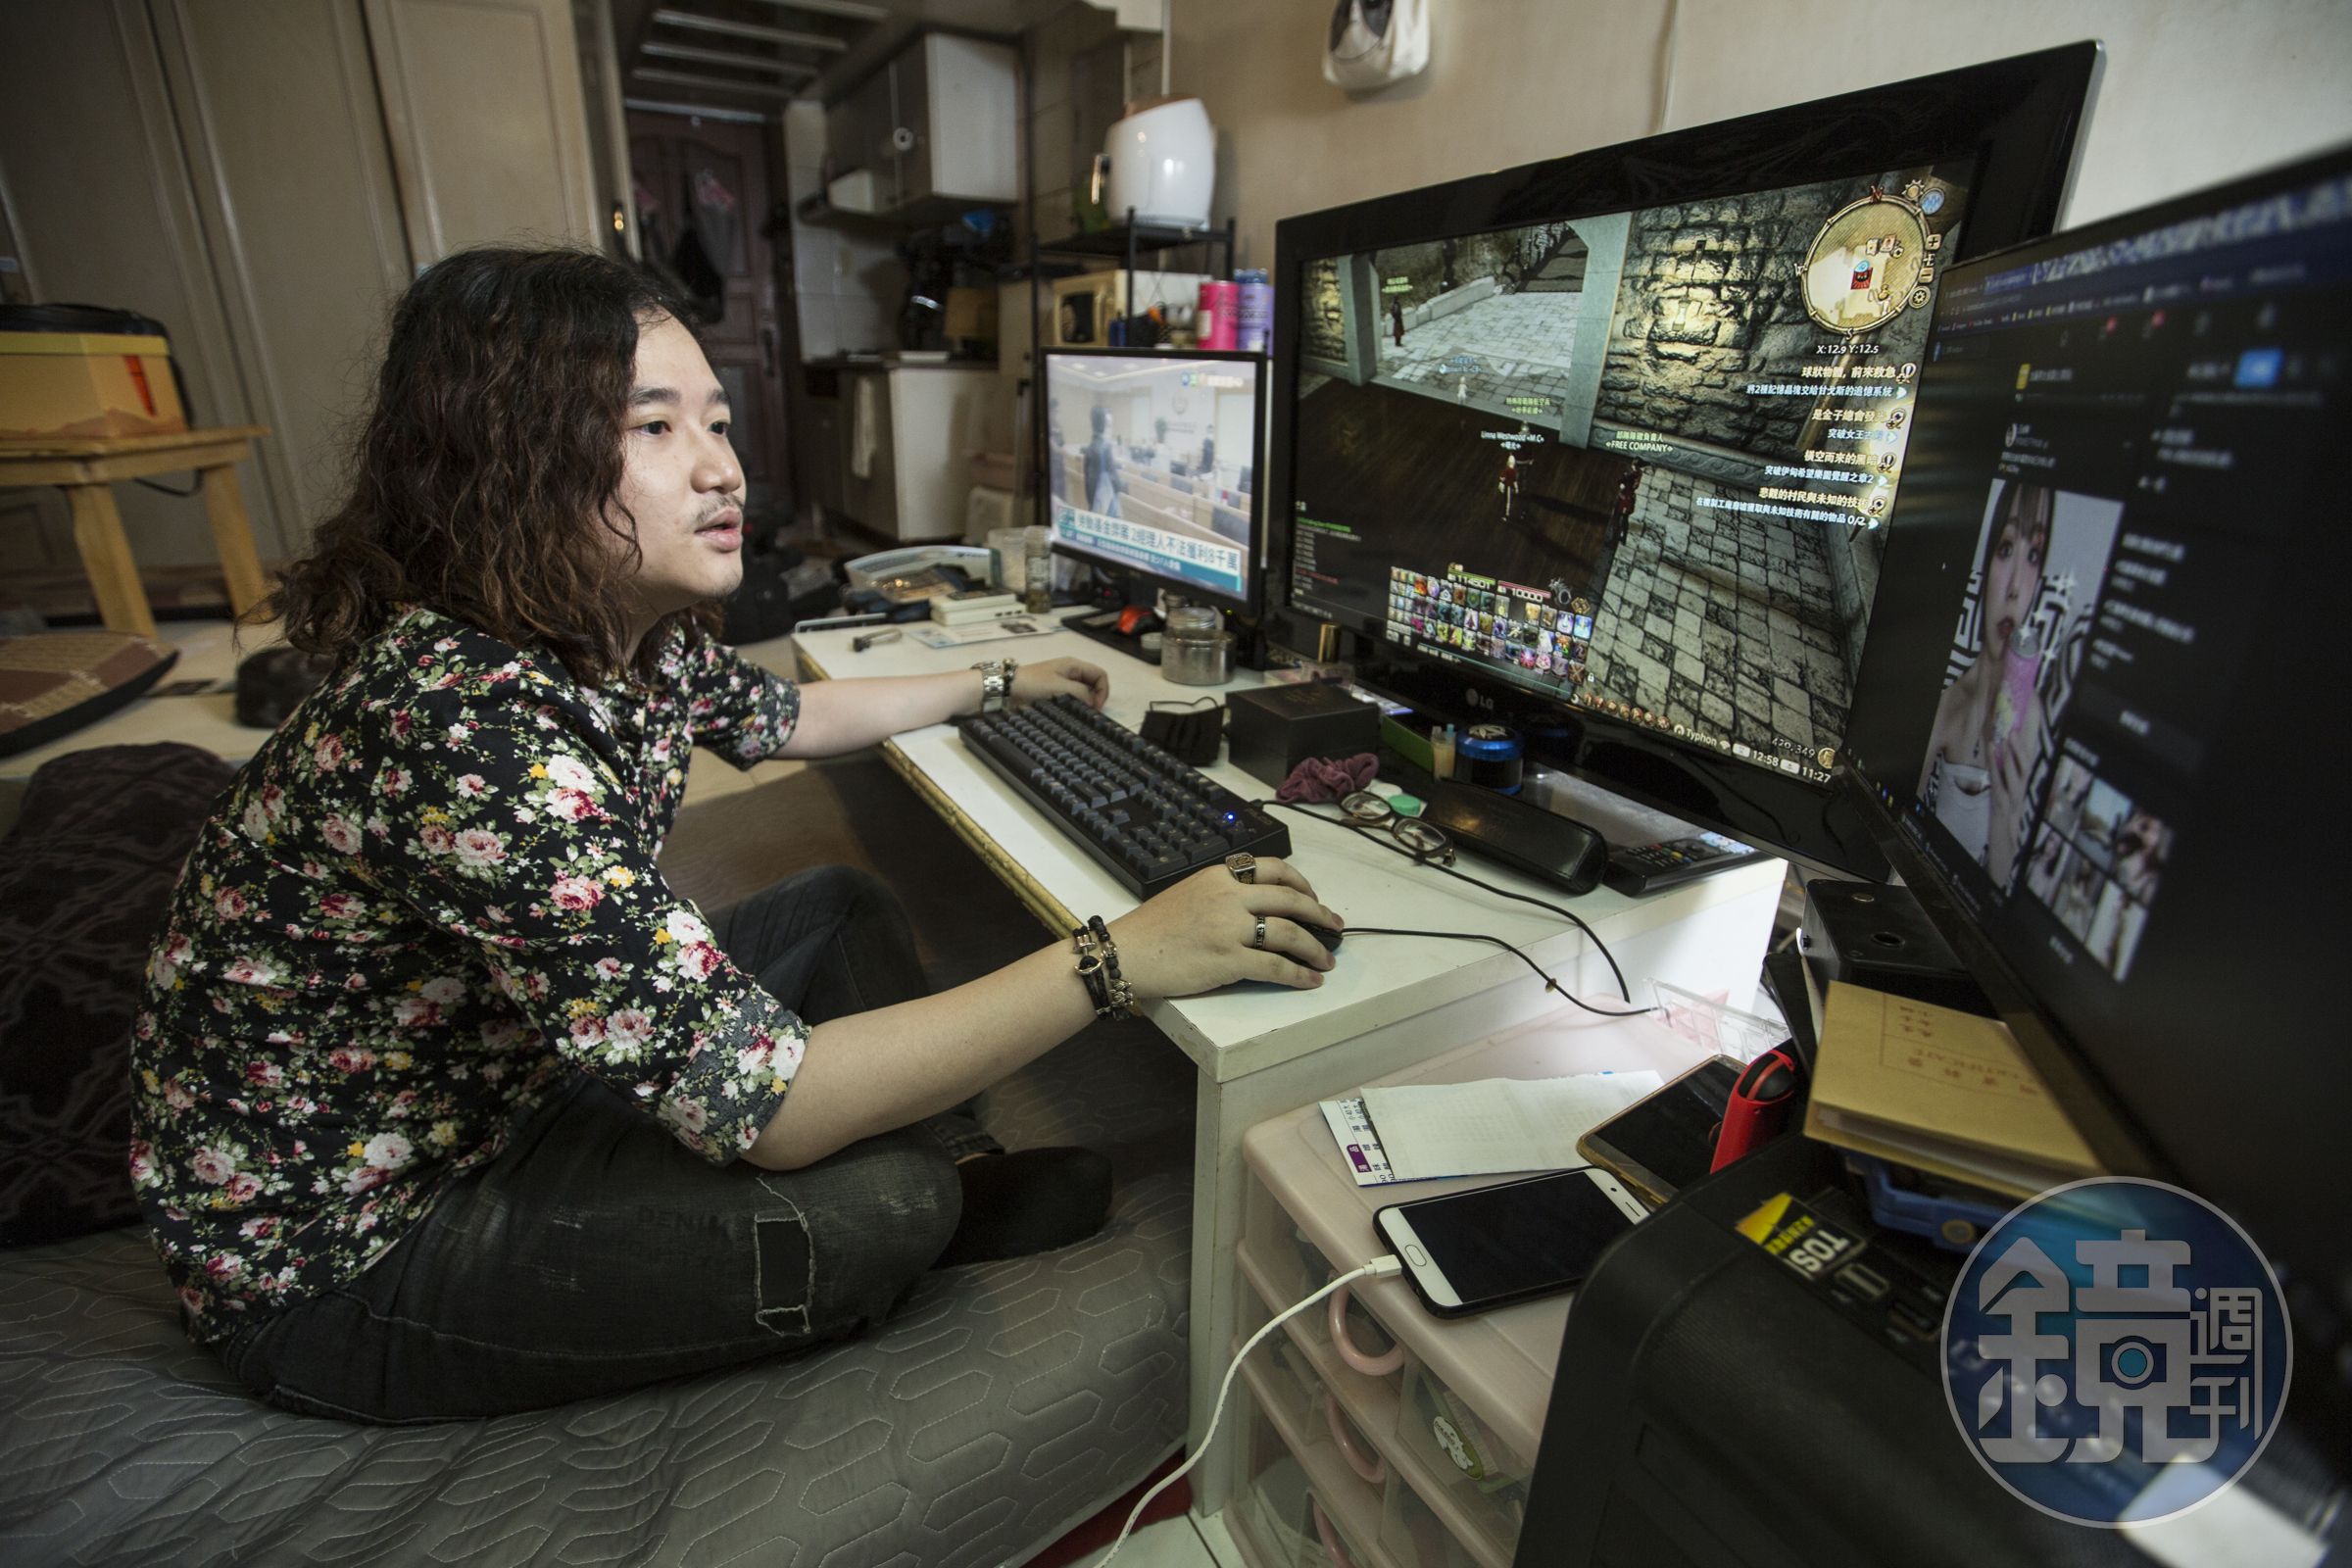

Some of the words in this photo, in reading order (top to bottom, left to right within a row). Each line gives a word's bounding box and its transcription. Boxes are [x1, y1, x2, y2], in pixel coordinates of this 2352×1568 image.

[1848, 344, 1879, 355] Y:12.5
[1479, 694, 1494, 710] LG
[1686, 728, 1718, 748] Typhon
[1752, 750, 1780, 767] 12:58
[1801, 766, 1832, 784] 11:27
